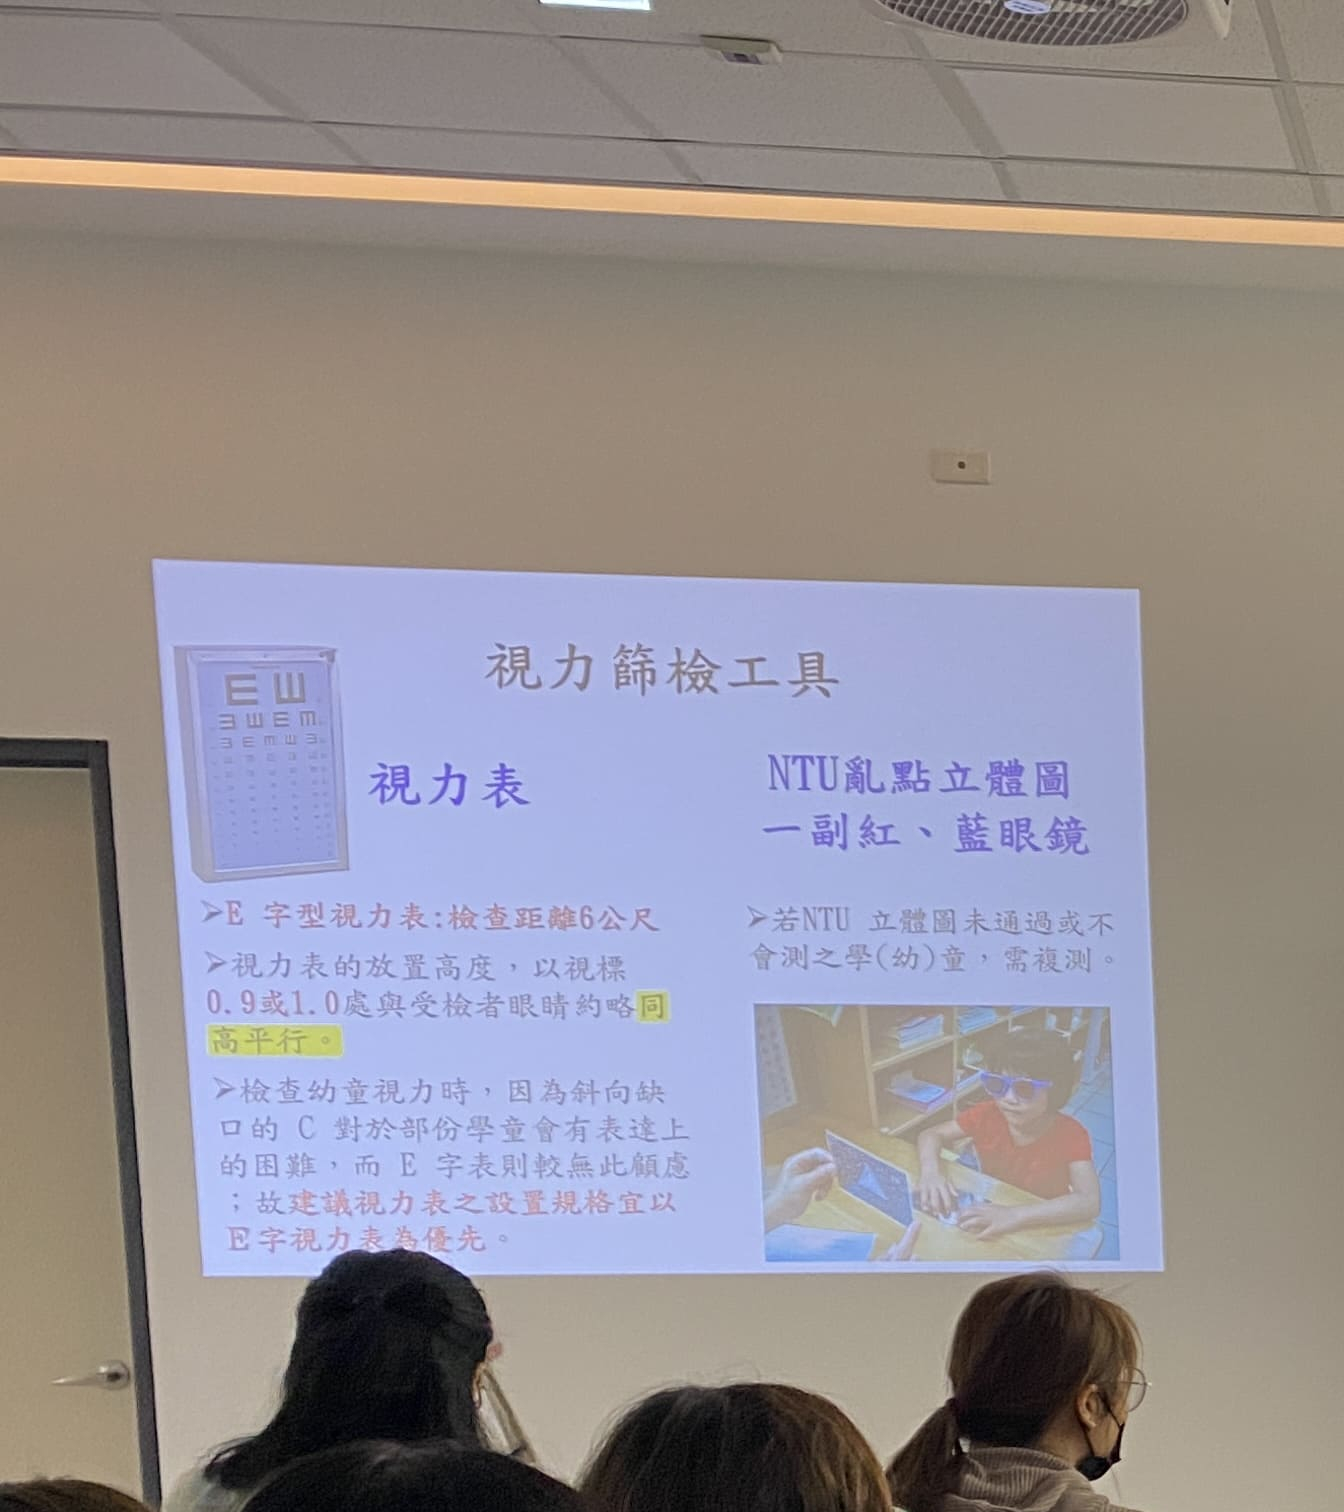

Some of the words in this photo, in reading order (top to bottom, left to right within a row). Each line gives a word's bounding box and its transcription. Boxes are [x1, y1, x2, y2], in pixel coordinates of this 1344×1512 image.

[484, 641, 839, 698] 視力篩檢工具
[368, 761, 531, 809] 視力表
[767, 753, 1070, 800] NTU亂點立體圖
[763, 811, 1090, 856] 一副紅、藍眼鏡
